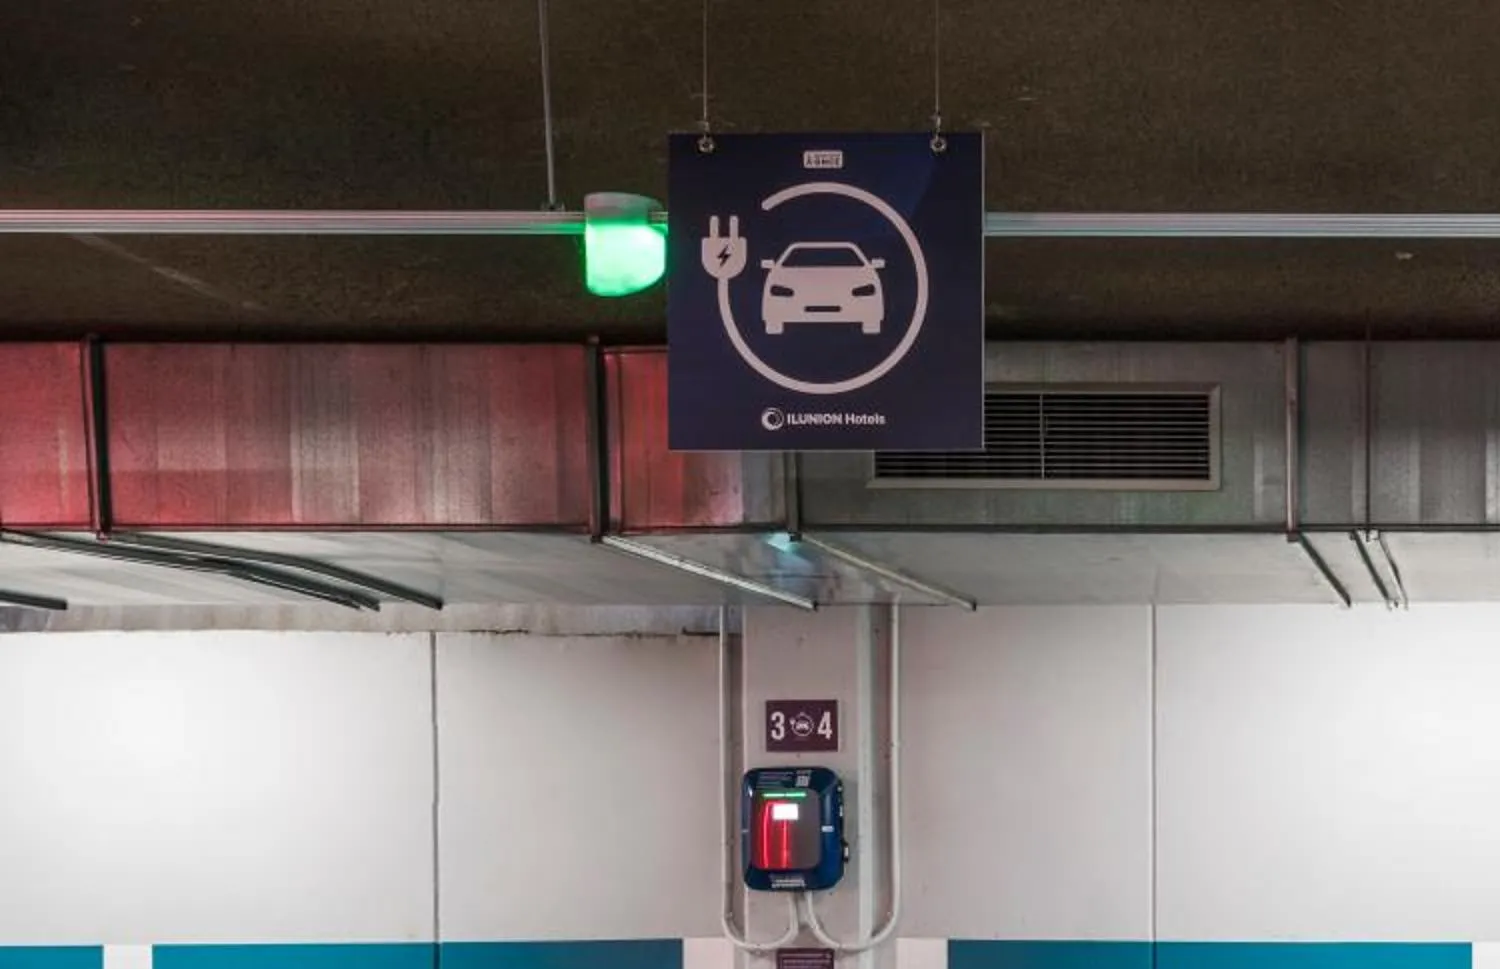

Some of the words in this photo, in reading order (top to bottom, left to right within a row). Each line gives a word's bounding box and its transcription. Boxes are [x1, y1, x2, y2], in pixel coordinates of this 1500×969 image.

[787, 413, 843, 425] ILUNION
[845, 413, 886, 425] Hotels
[770, 711, 786, 740] 3
[817, 711, 833, 740] 4
